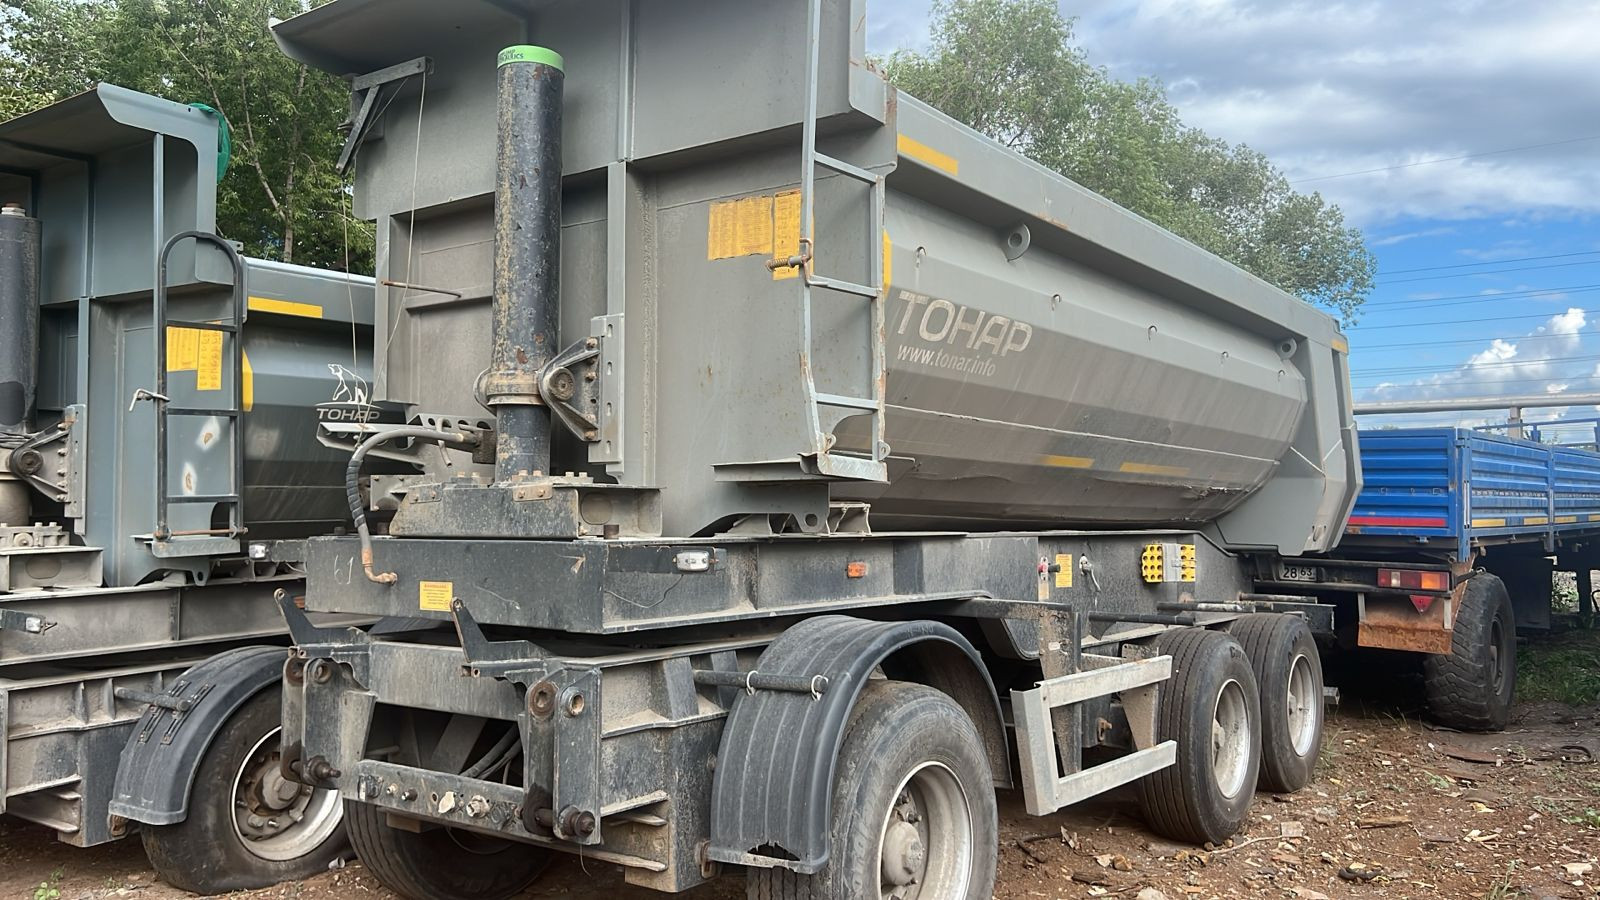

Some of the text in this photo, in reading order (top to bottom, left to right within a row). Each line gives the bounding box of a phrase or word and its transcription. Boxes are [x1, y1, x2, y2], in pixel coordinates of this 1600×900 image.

[897, 290, 1033, 357] ТОНАР
[897, 344, 996, 377] www.tonar.info
[316, 408, 380, 422] ТОНАР
[1300, 566, 1313, 577] 63
